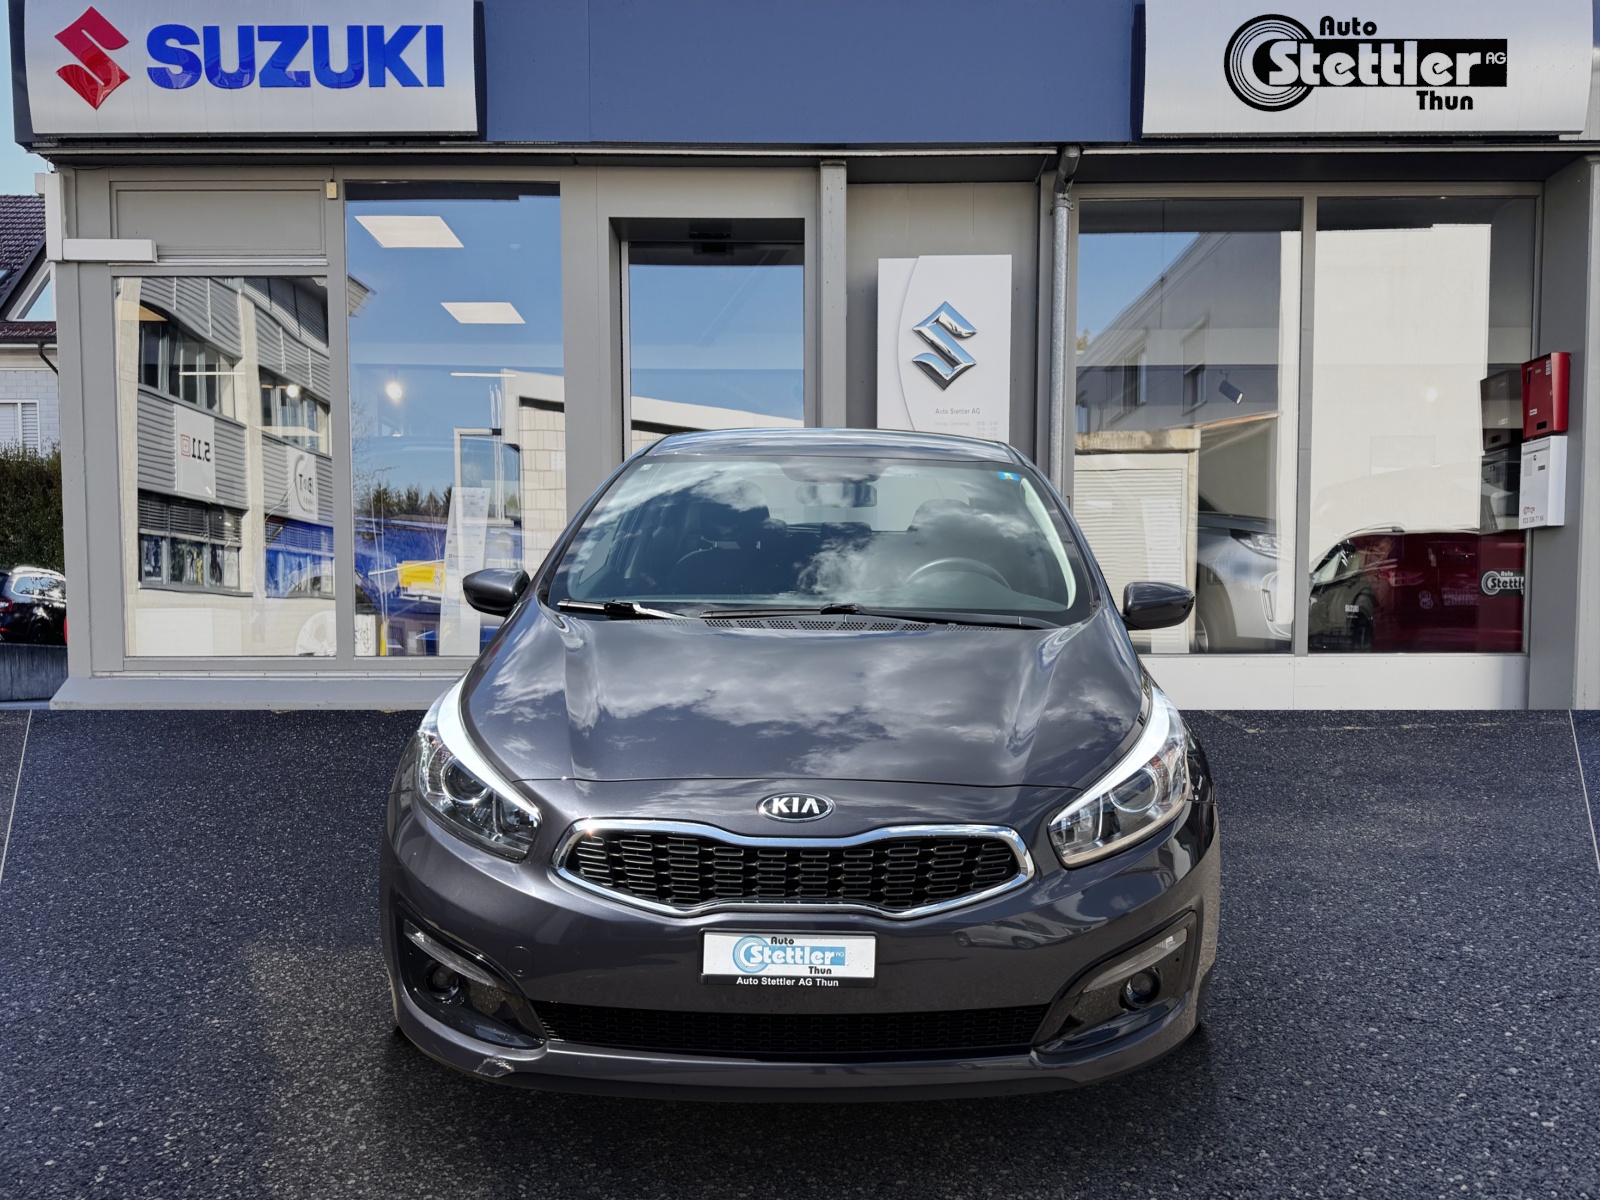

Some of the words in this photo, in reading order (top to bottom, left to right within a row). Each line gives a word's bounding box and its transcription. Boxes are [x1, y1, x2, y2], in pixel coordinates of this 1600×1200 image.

[1319, 15, 1378, 36] Auto
[146, 24, 445, 89] SUZUKI
[1268, 40, 1482, 87] Stettler
[1485, 52, 1507, 65] AG
[1416, 90, 1474, 111] Thun
[971, 407, 981, 415] AG
[772, 797, 820, 814] KIA
[771, 936, 795, 945] Auto
[750, 945, 834, 965] Stettler
[809, 966, 832, 975] Thun
[736, 977, 759, 985] Auto
[761, 977, 795, 986] Stettler
[798, 978, 812, 986] AG
[815, 978, 839, 987] Thun
